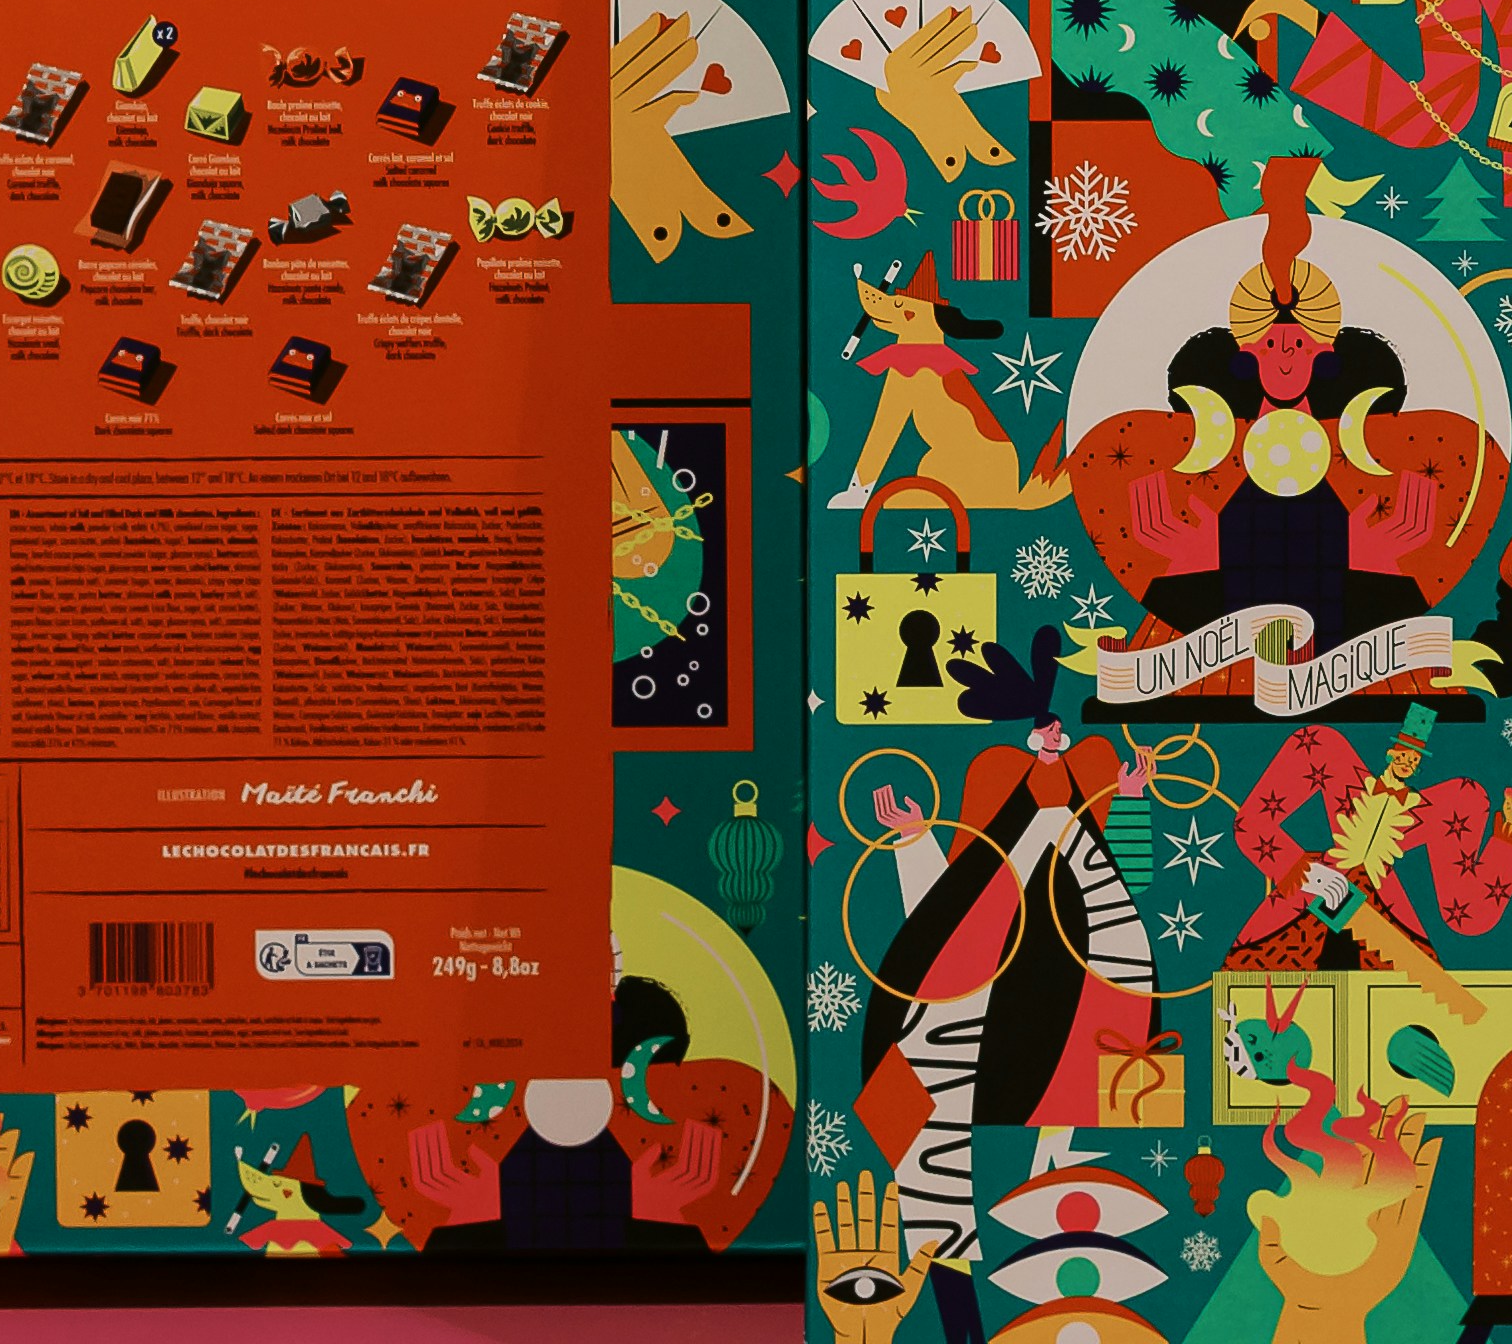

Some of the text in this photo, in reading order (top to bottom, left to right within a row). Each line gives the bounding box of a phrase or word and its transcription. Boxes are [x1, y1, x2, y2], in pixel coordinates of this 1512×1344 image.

[1134, 648, 1176, 695] UN
[1184, 617, 1250, 682] NOËL
[241, 779, 440, 806] Maïté Franchi
[432, 956, 477, 982] 249g
